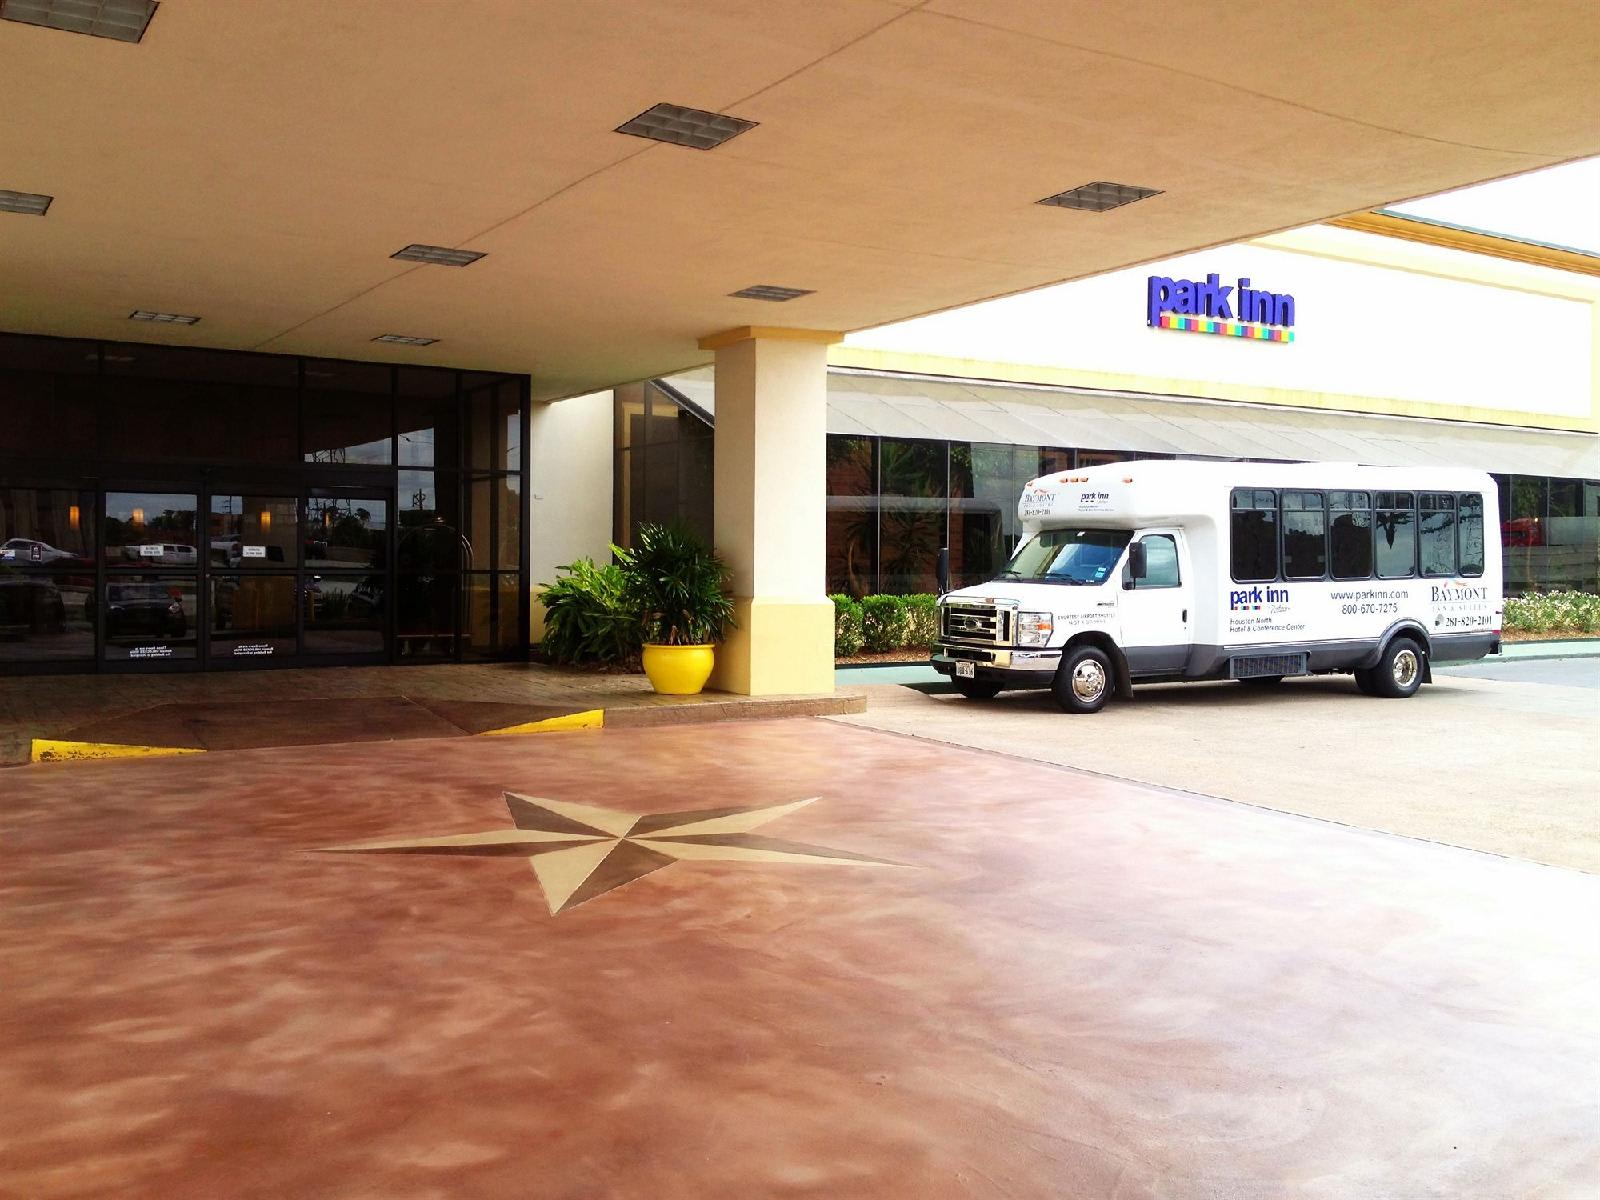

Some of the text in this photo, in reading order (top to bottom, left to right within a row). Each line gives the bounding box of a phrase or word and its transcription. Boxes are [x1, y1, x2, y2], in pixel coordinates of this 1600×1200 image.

[1147, 273, 1295, 327] park inn
[1230, 586, 1263, 610] park
[1266, 586, 1289, 603] inn
[1330, 589, 1409, 602] www.parkinn.com
[1431, 586, 1488, 601] BAYMONT
[1341, 603, 1398, 614] 800-670-7275
[1445, 616, 1492, 626] 281-820-2101
